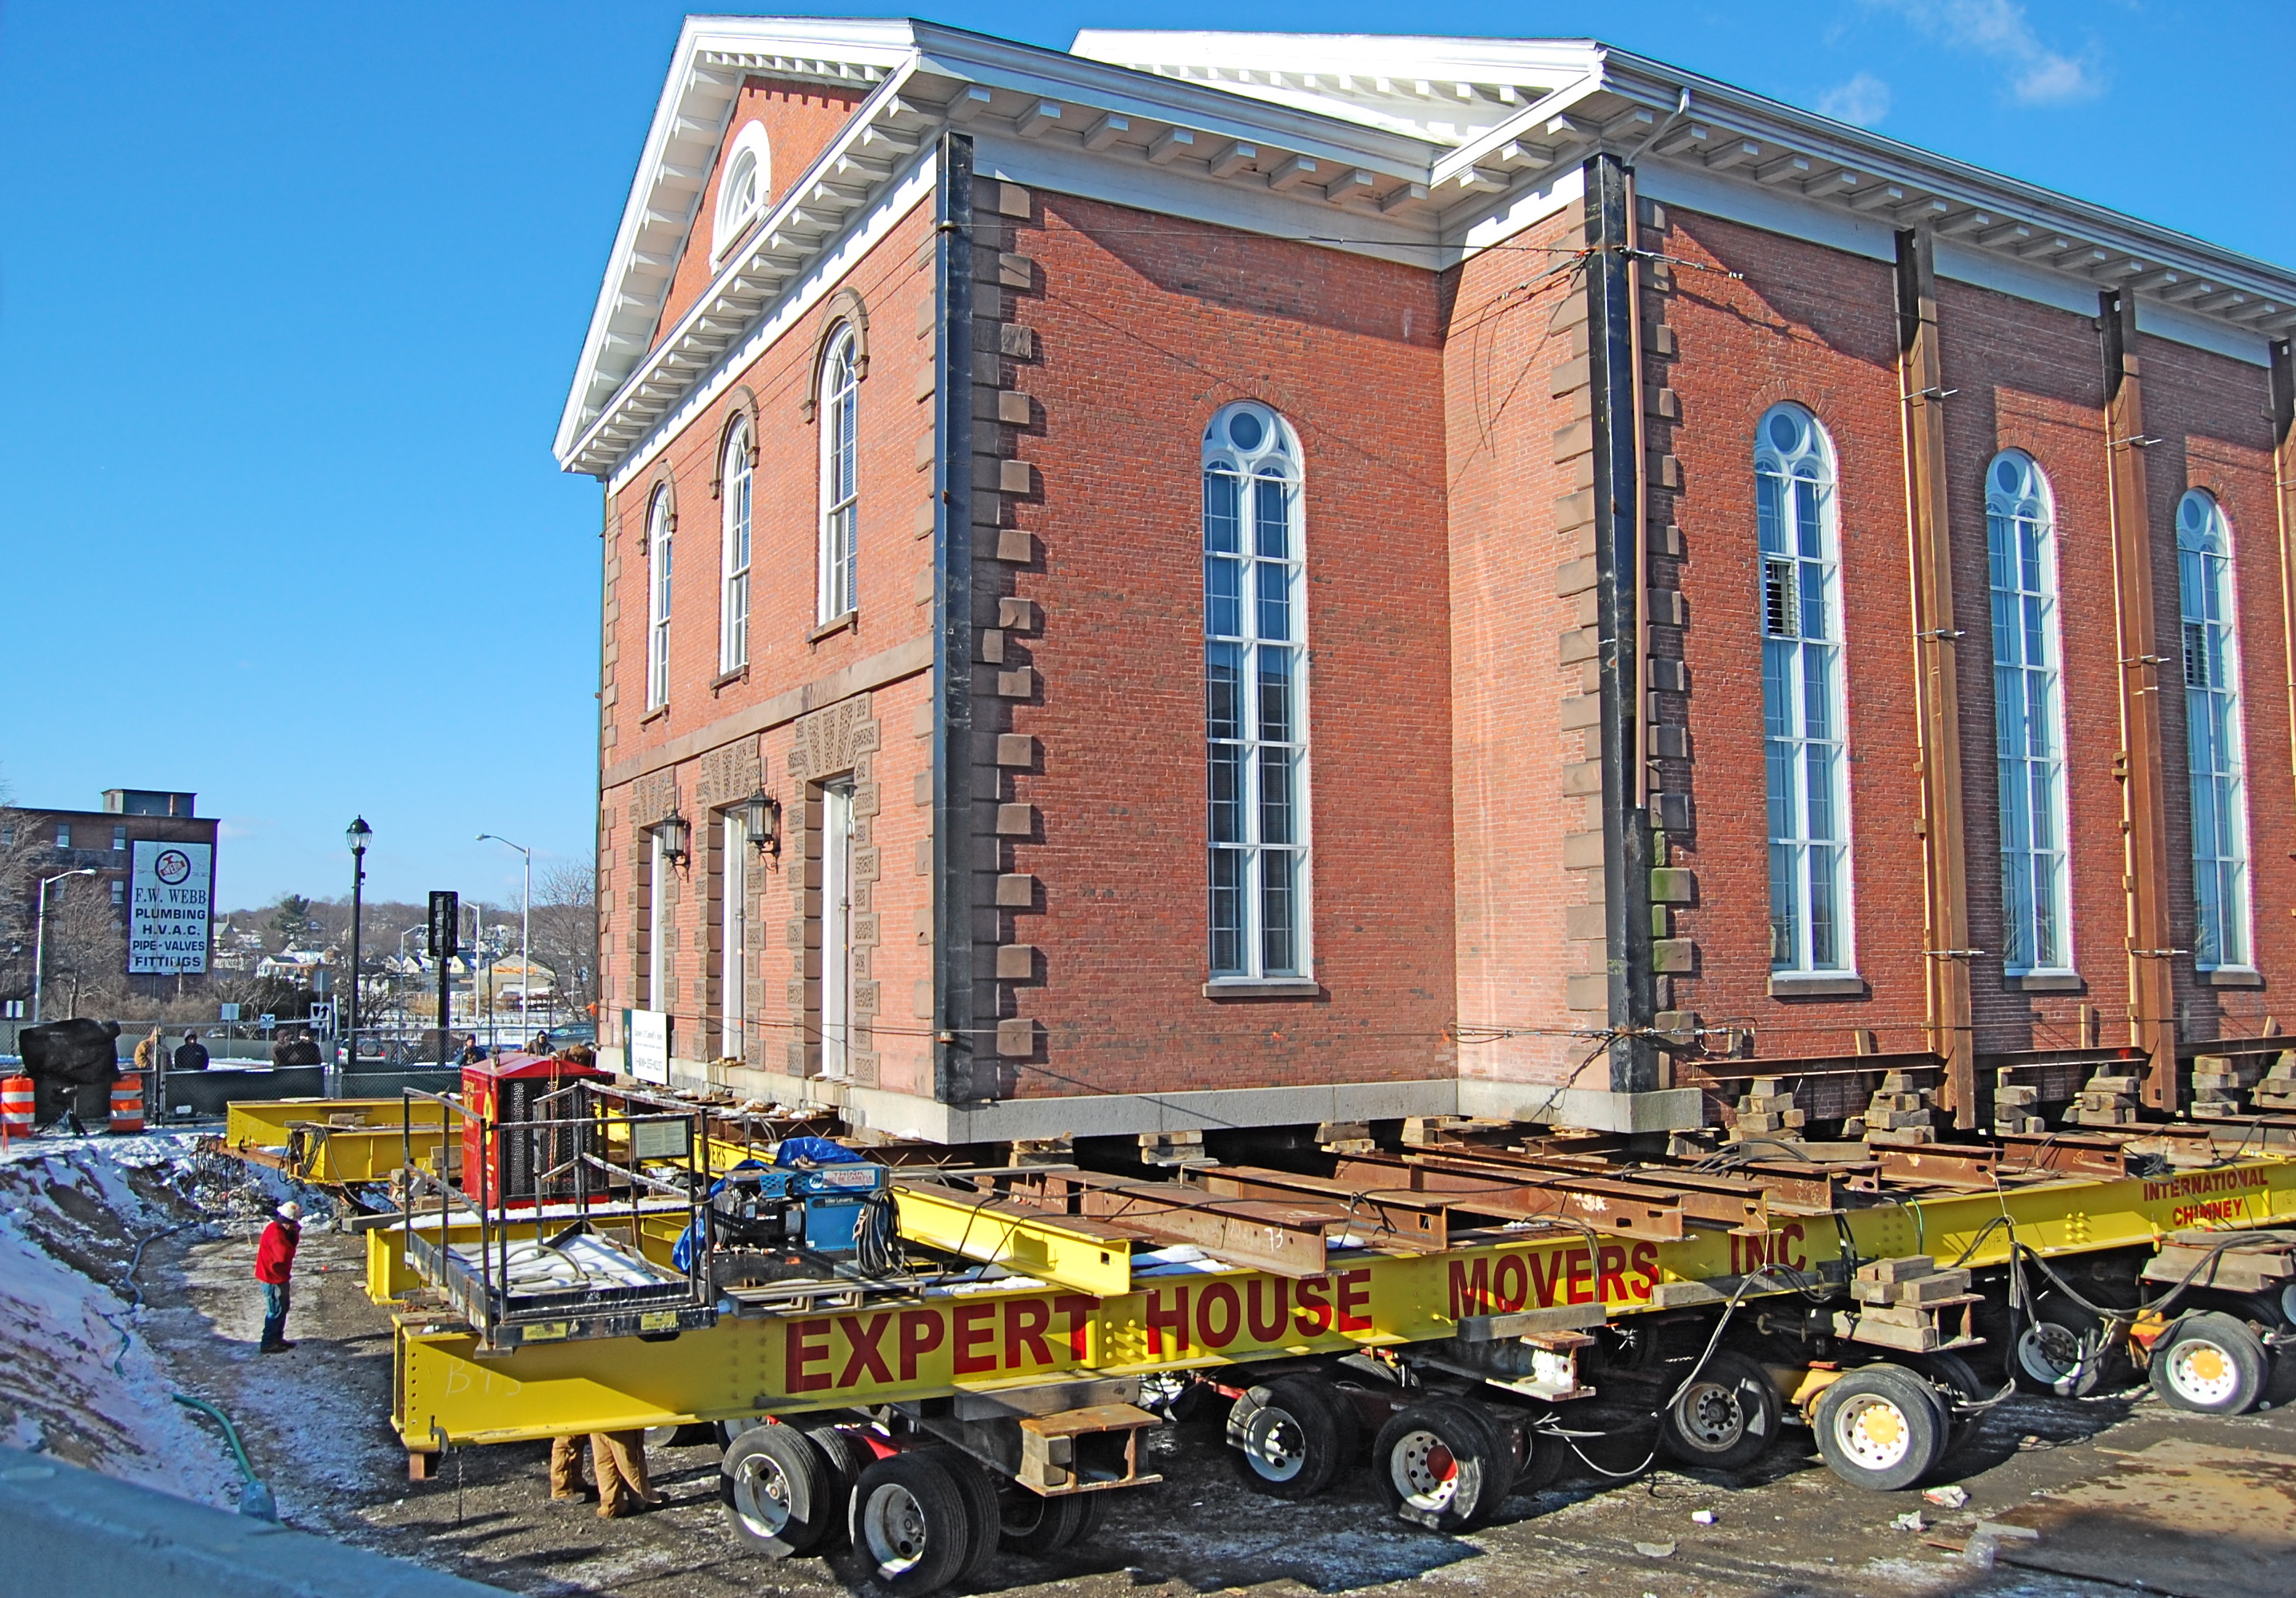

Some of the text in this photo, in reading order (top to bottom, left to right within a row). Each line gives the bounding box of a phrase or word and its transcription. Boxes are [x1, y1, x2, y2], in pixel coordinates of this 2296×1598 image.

[134, 887, 206, 905] F.W. WEBB
[135, 908, 205, 920] PLUMBING
[142, 924, 201, 935] H.V.A.C.
[135, 956, 201, 967] FITTINGS
[2143, 1167, 2269, 1202] INTERNATIONAL
[2172, 1198, 2243, 1226] CHIMNEY
[785, 1224, 1807, 1395] EXPERT HOUSE MOVERS INC
